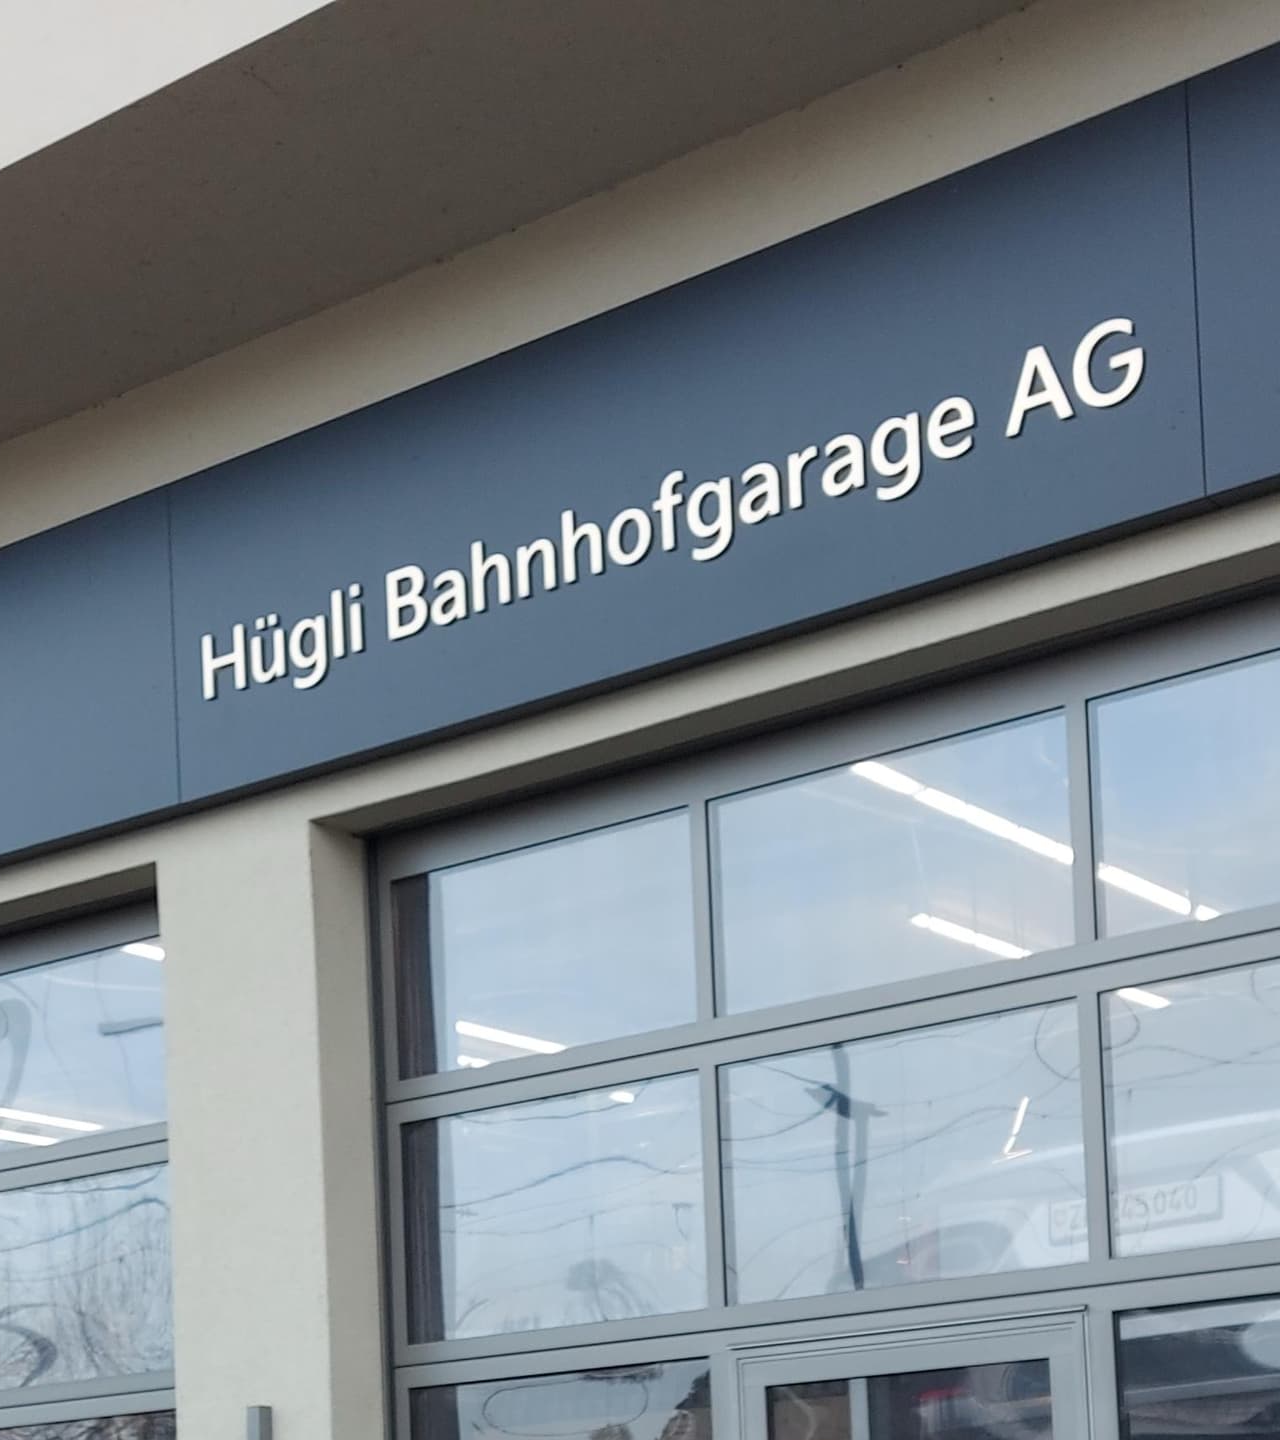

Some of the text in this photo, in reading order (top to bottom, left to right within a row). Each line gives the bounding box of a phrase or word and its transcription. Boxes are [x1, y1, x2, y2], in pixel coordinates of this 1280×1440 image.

[201, 317, 1145, 701] Hügli Bahnhofgarage AG
